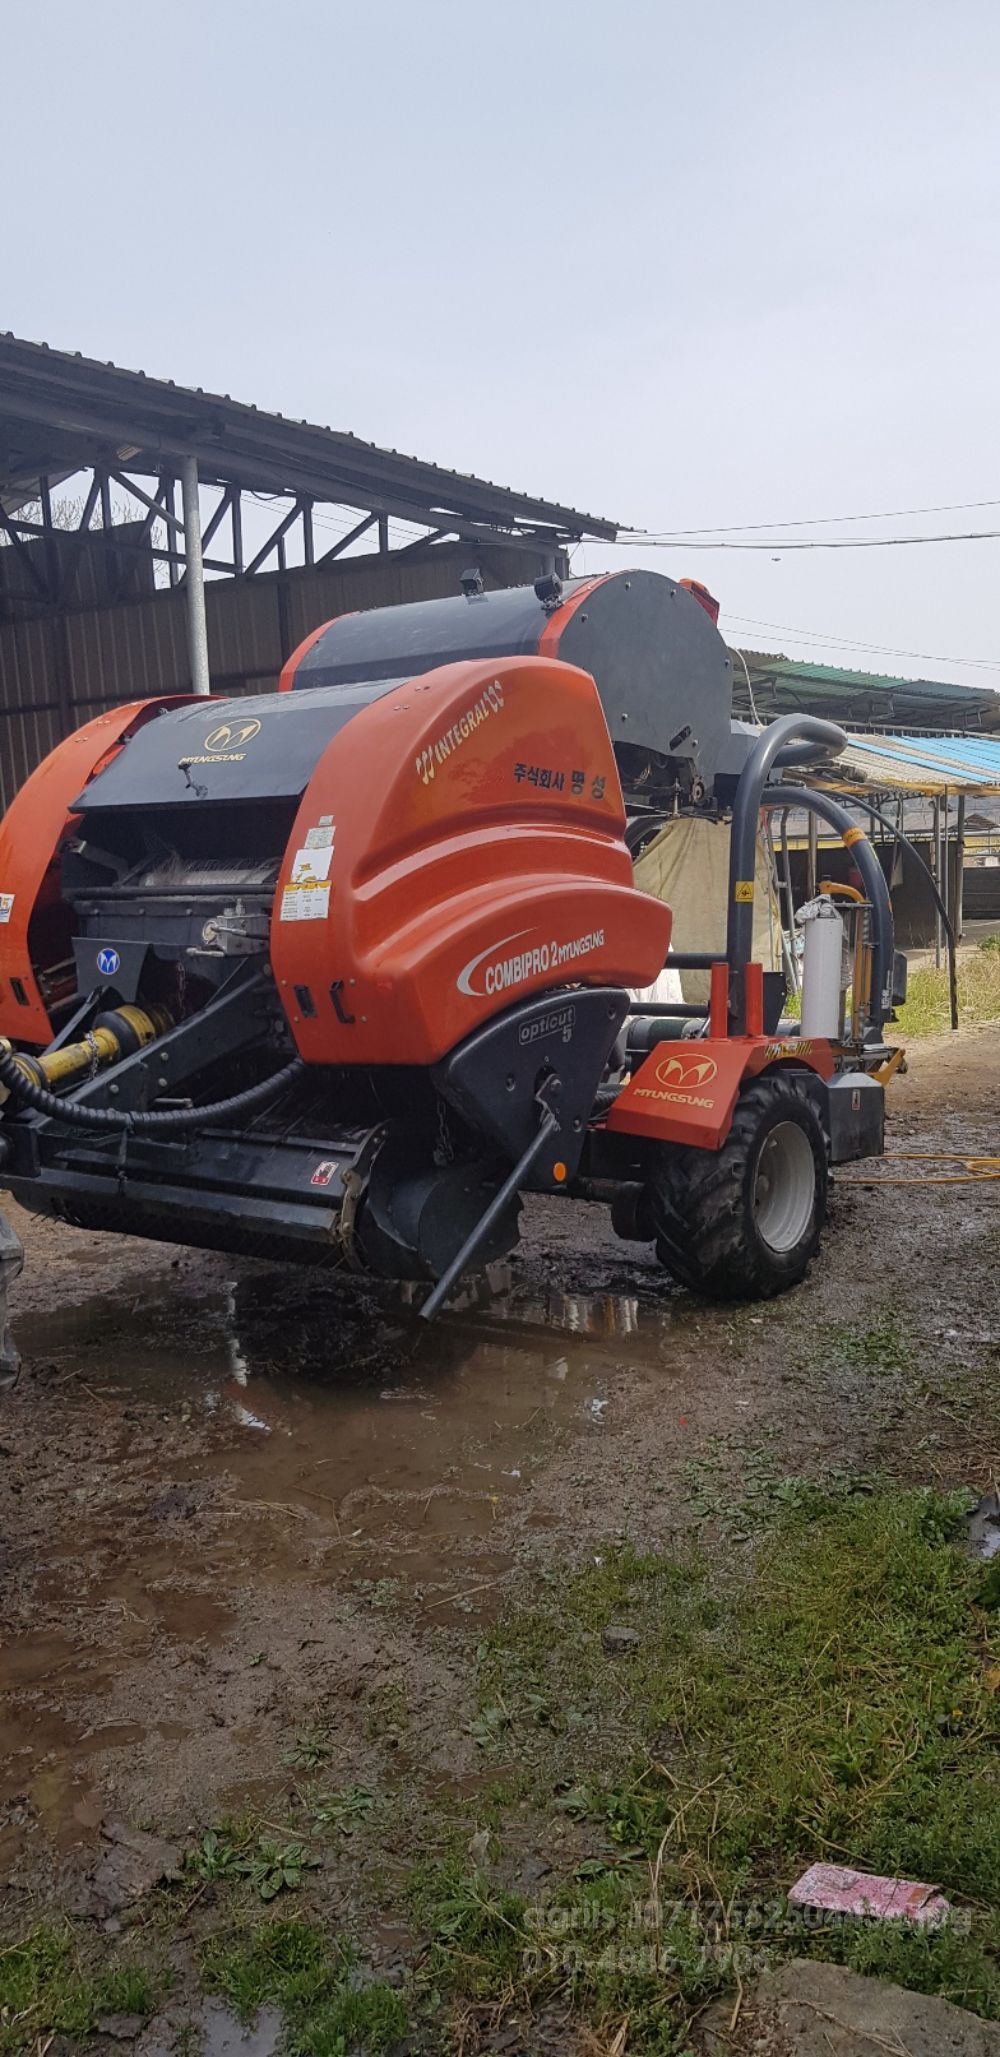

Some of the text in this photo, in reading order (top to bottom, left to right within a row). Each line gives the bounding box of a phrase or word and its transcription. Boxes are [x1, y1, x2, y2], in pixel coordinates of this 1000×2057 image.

[435, 698, 489, 764] INTEGRAL
[514, 763, 565, 791] 주식회사
[485, 929, 605, 995] COMBIPRO 2 MYUNGSUNG
[520, 1009, 574, 1040] opticut
[562, 1024, 572, 1042] 5
[633, 1088, 715, 1110] MYUNGSUNG
